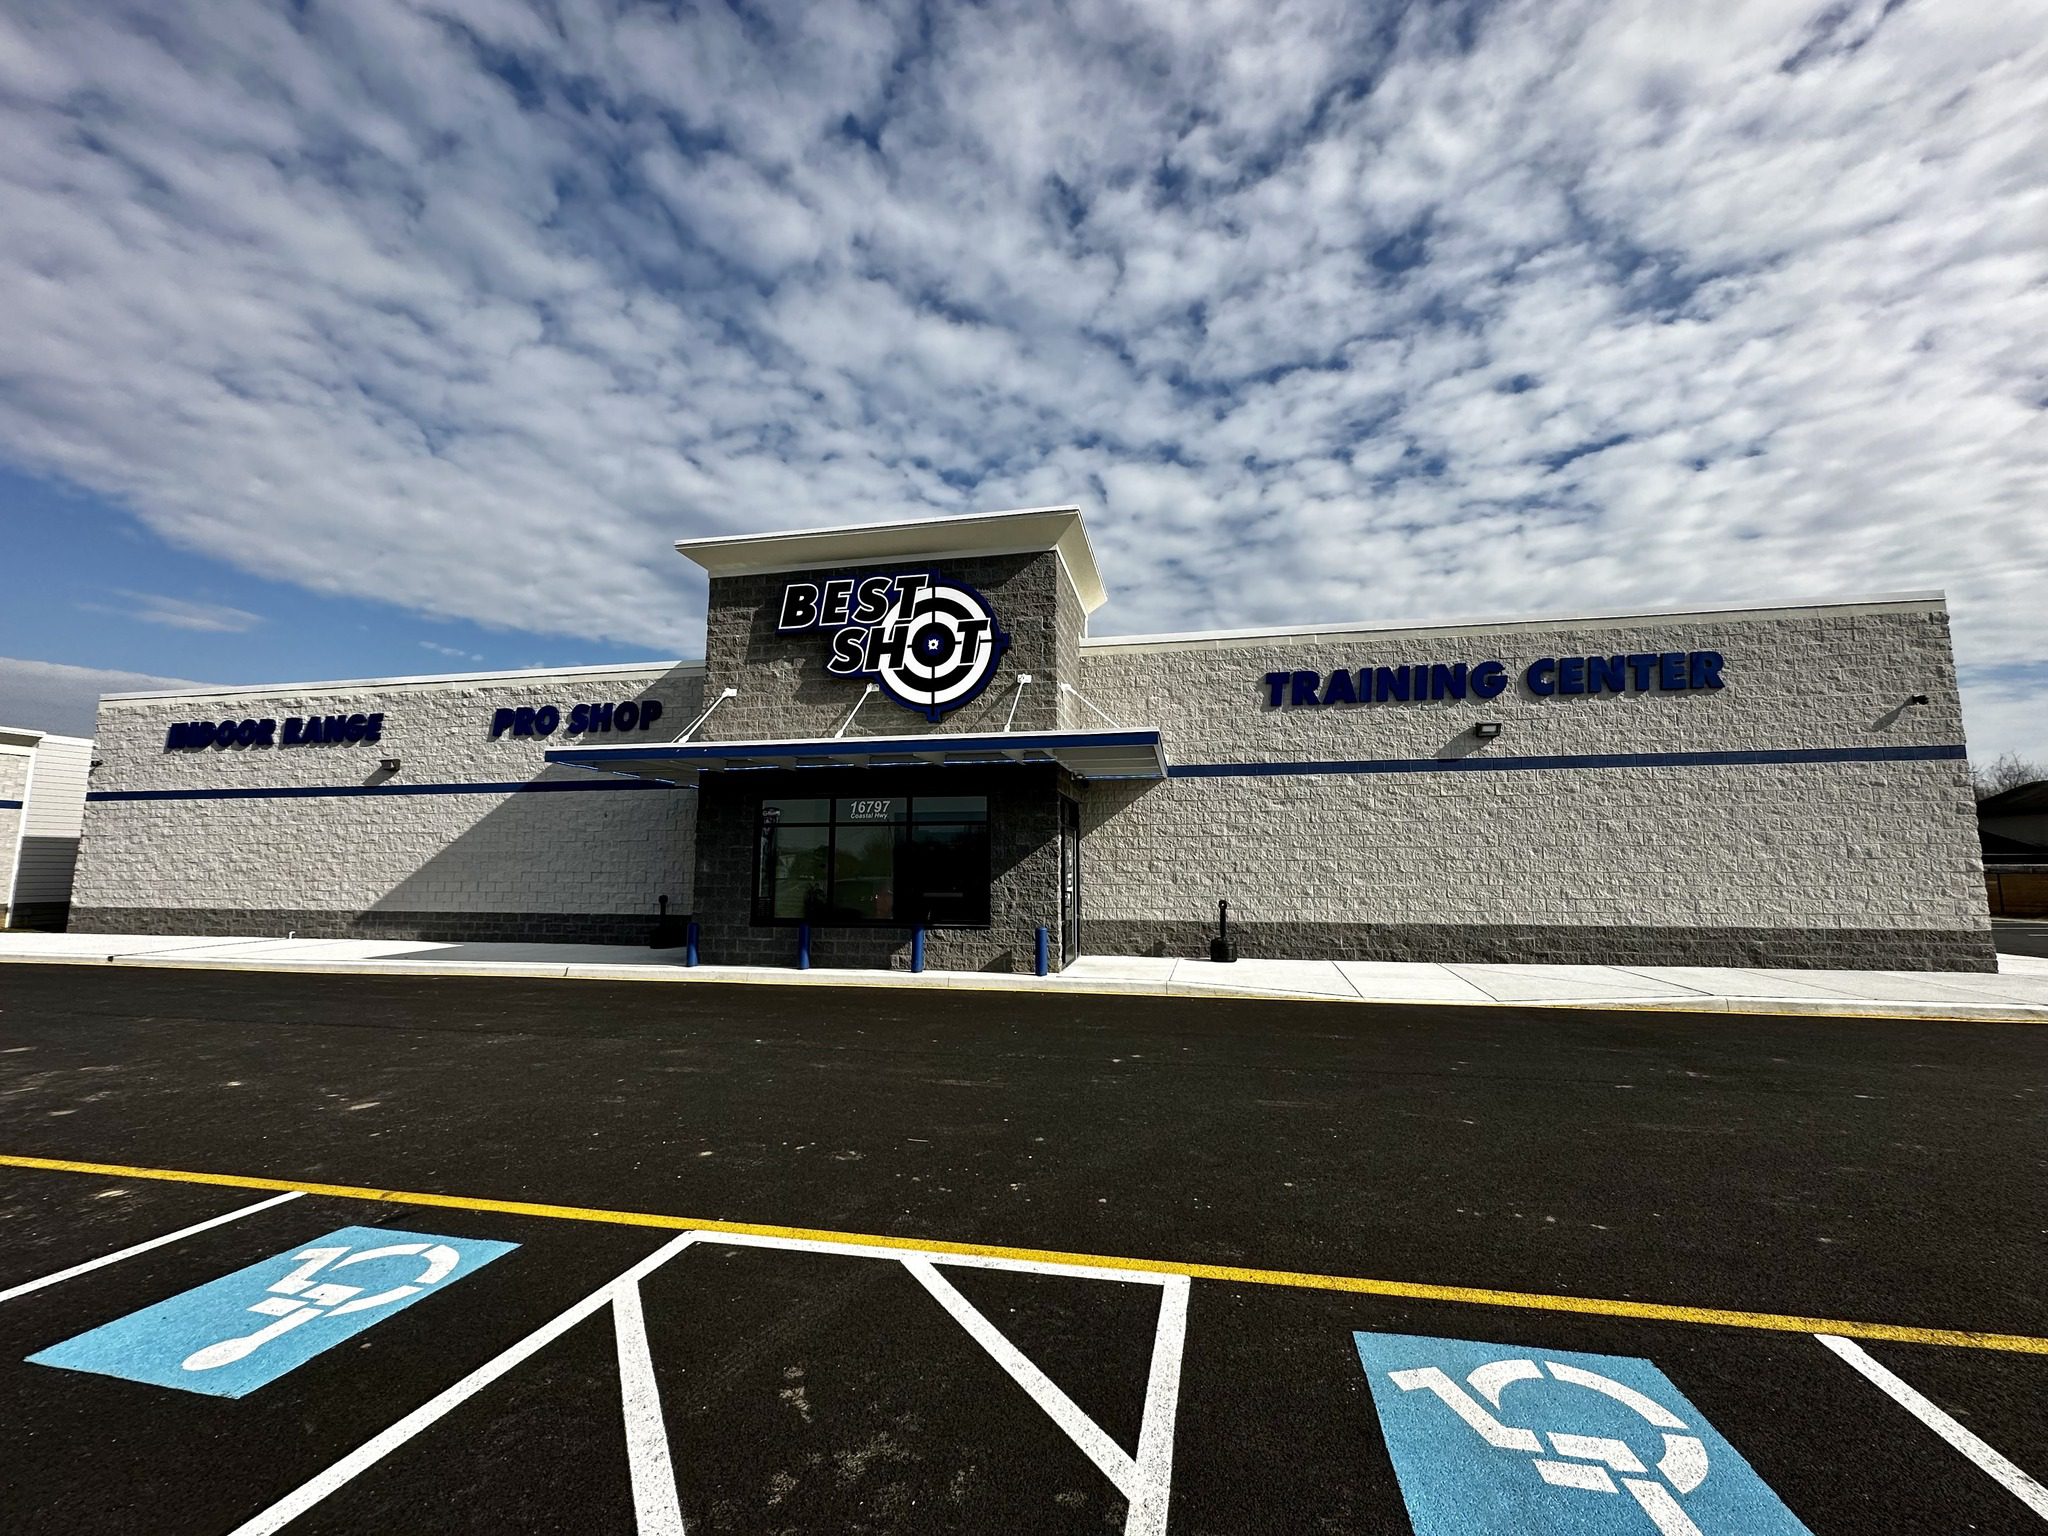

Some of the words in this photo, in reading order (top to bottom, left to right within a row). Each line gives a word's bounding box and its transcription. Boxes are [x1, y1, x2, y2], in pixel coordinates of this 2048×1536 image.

[778, 573, 930, 630] BEST
[826, 616, 992, 674] SHOT
[1265, 660, 1509, 707] TRAINING
[1527, 651, 1726, 696] CENTER
[167, 719, 277, 749] INDOOR
[282, 713, 385, 745] RANGE
[492, 704, 561, 737] PRO
[568, 700, 664, 735] SHOP
[850, 800, 890, 813] 16797
[874, 812, 888, 820] Hwy
